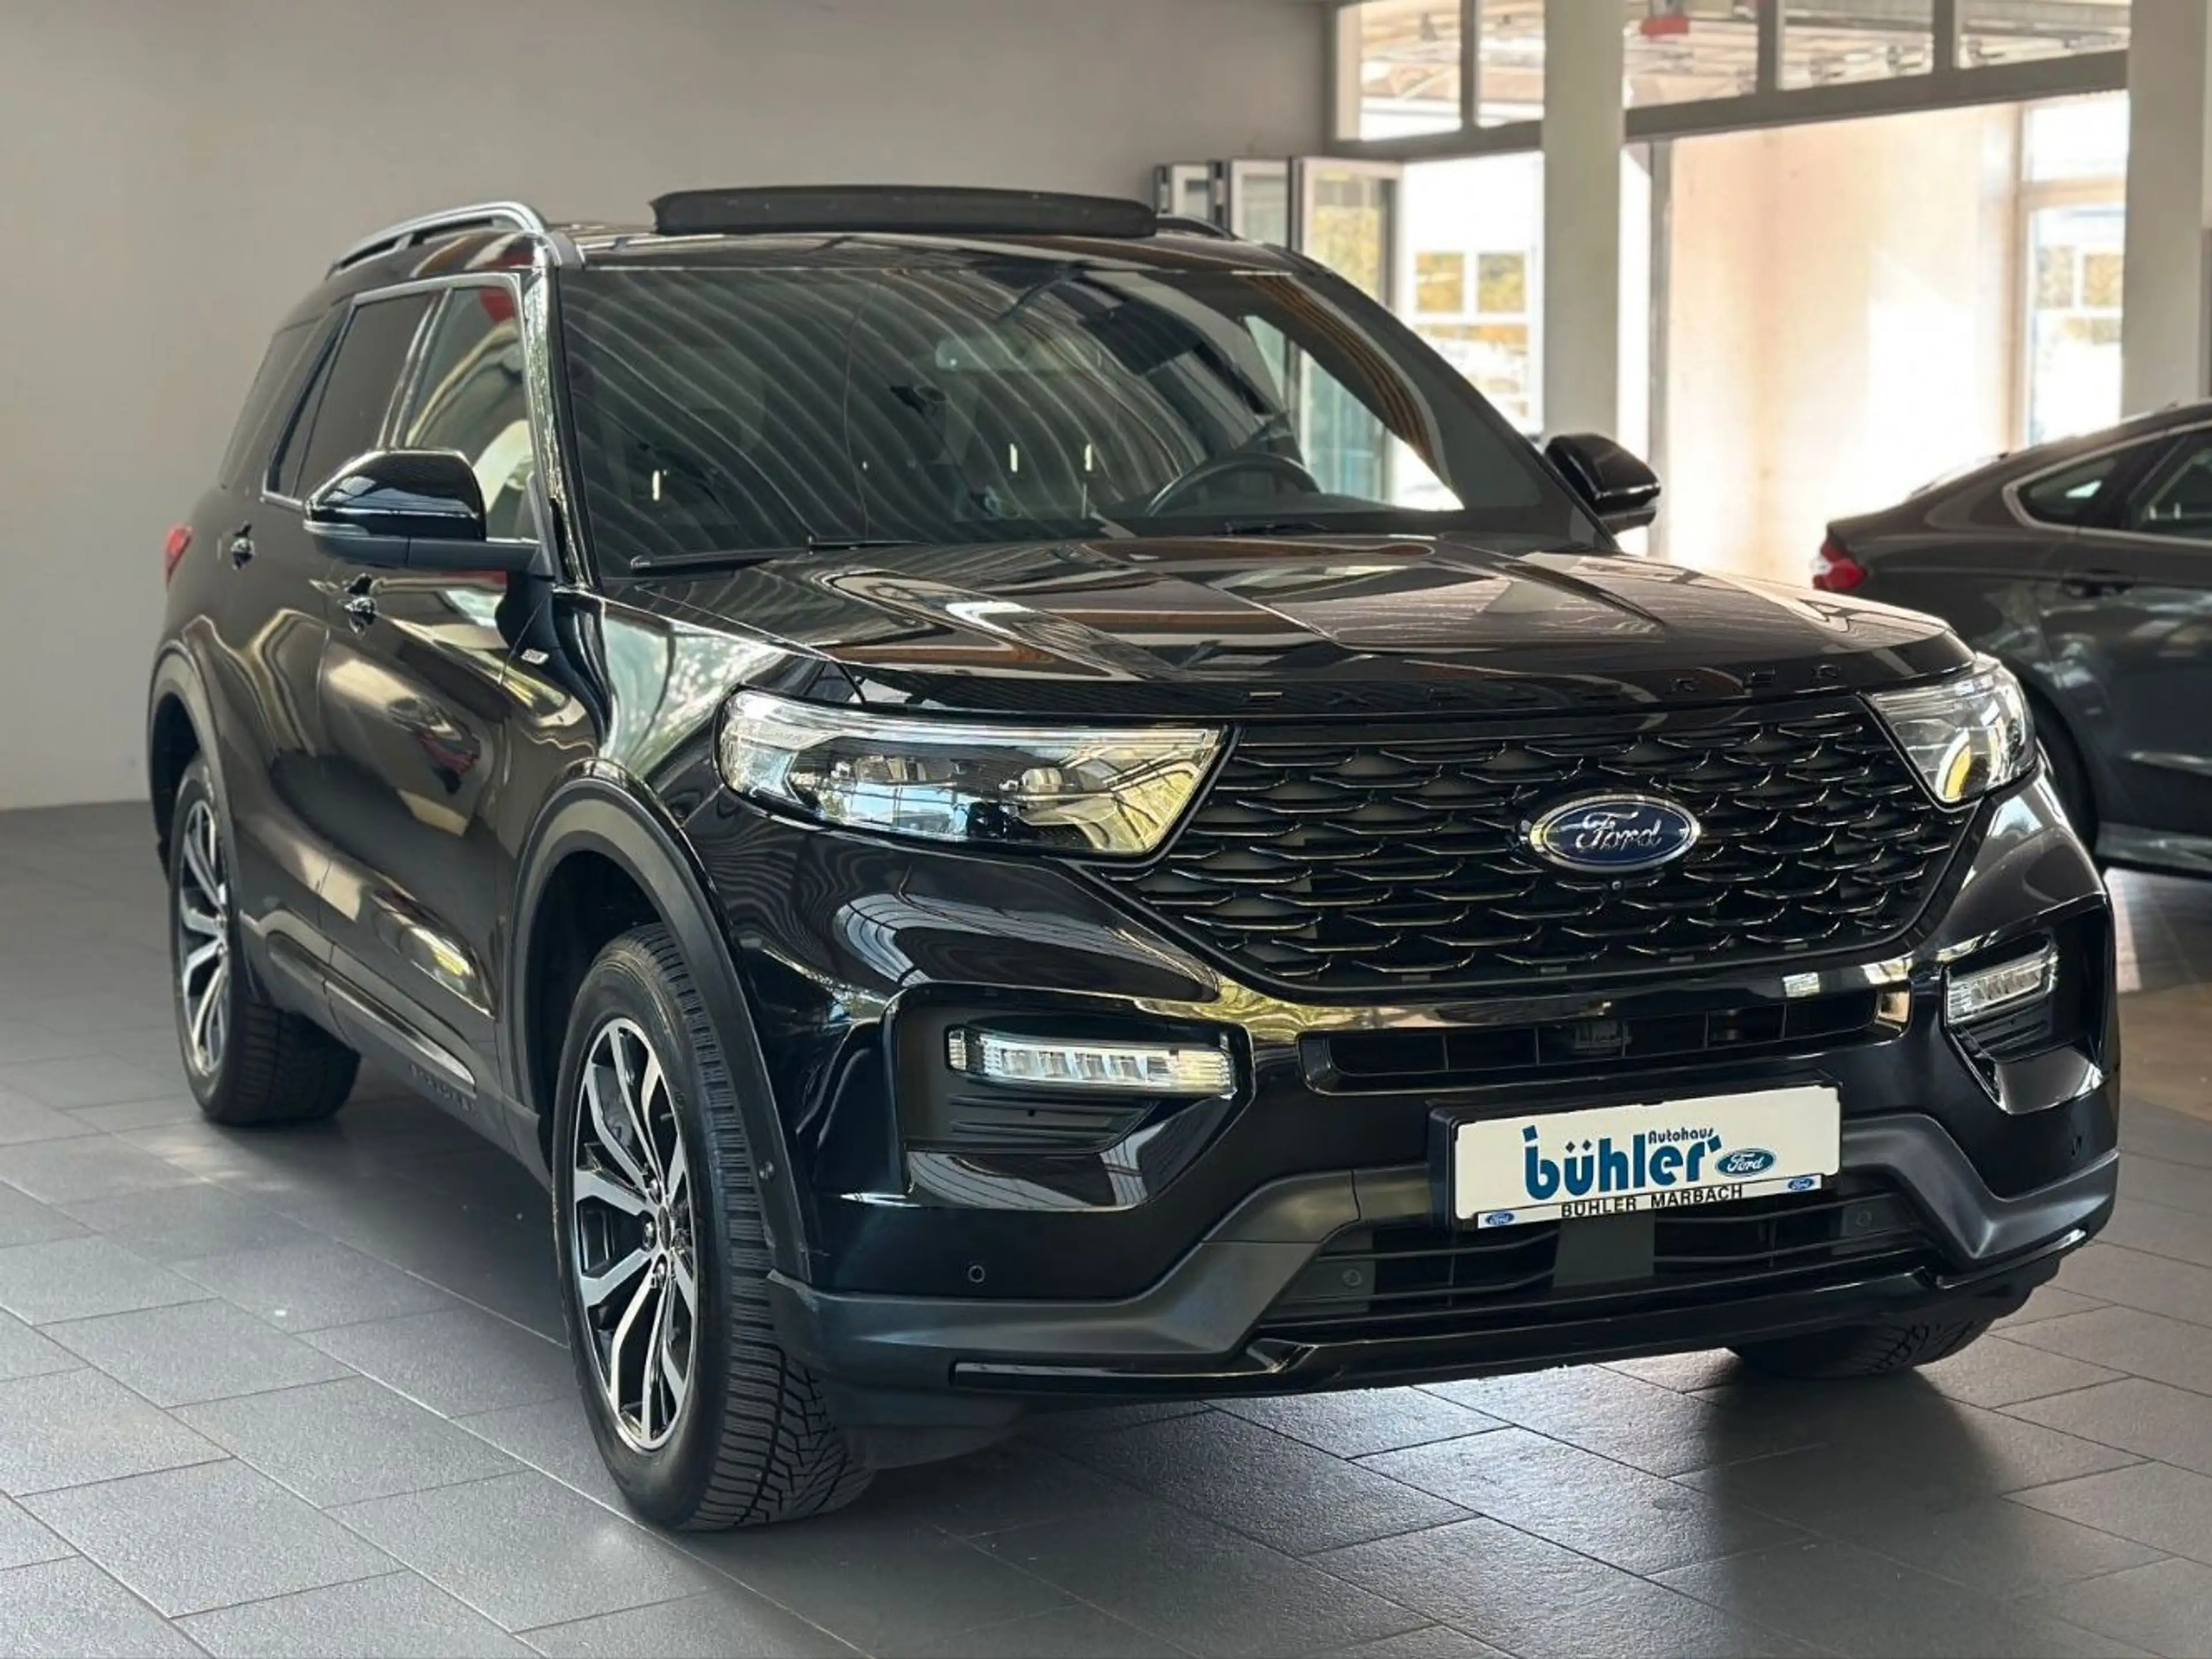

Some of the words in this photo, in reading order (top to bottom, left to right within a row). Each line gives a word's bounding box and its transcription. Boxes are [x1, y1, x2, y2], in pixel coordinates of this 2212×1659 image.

[1238, 664, 1842, 710] EXRER
[1575, 810, 1663, 851] Ford
[1647, 1127, 1714, 1145] Autohaus
[1522, 1124, 1722, 1200] bühler
[1726, 1153, 1765, 1173] Ford
[1651, 1184, 1742, 1209] MARBACH
